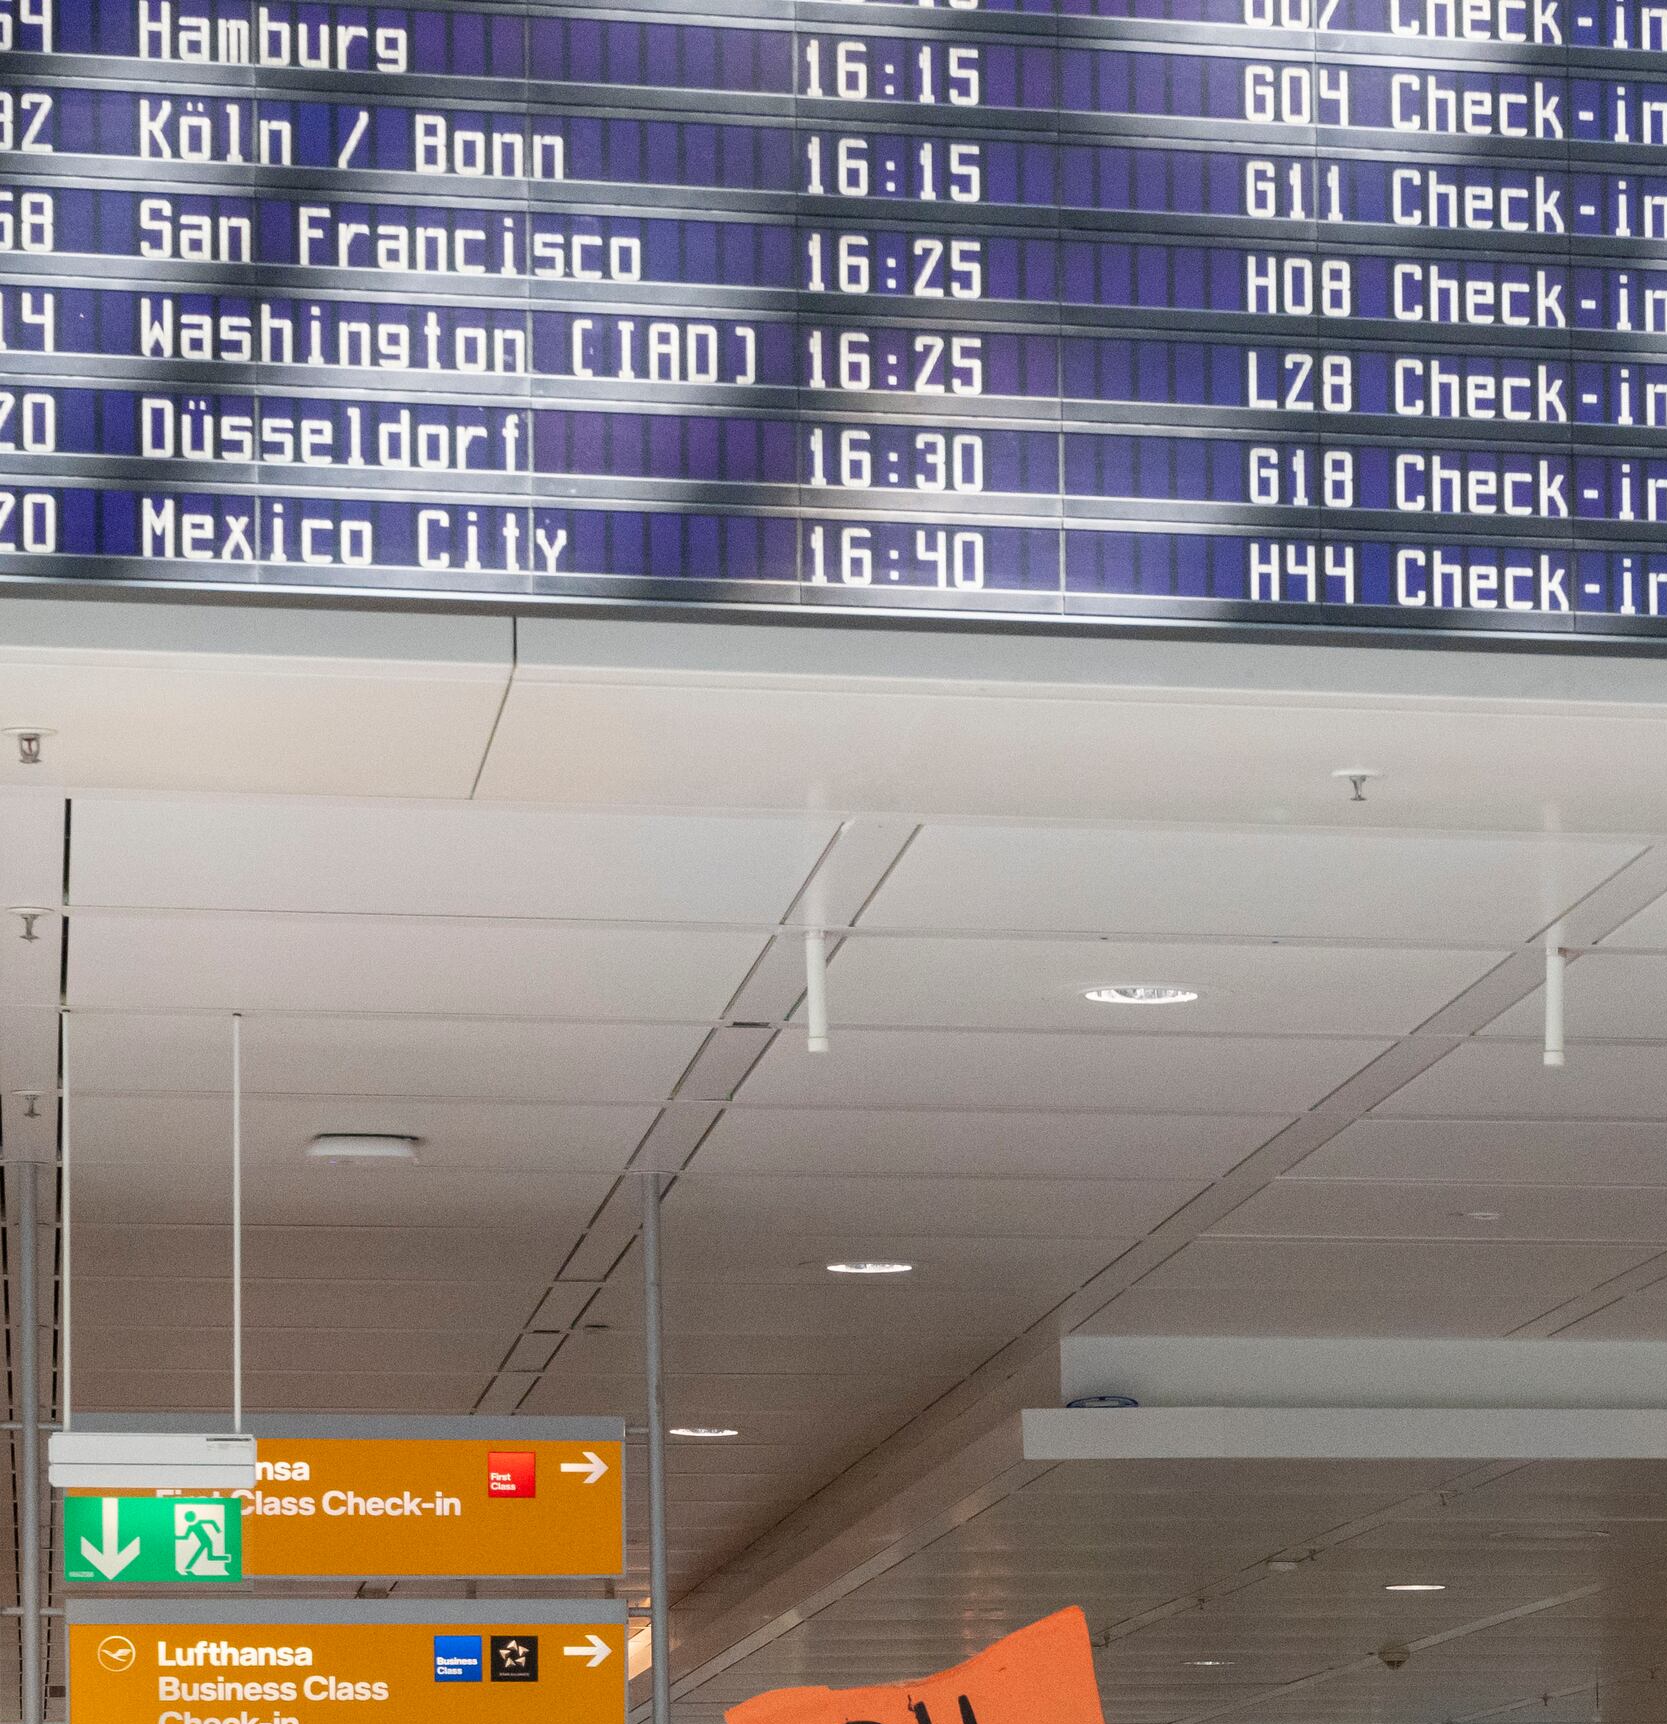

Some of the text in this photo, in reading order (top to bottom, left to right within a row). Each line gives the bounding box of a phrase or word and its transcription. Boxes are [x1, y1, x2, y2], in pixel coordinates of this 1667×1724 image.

[139, 0, 409, 75] Hamburg
[806, 39, 979, 105] 16:15
[1245, 65, 1349, 128] G04
[140, 99, 292, 165] Köln
[338, 111, 369, 169] /
[414, 114, 564, 180] Bonn
[808, 137, 981, 203] 16:15
[1246, 160, 1344, 224] G11
[140, 297, 526, 375] Washington
[810, 330, 983, 396] 16:25
[1248, 353, 1352, 414] L28
[142, 498, 373, 567] Mexico
[417, 511, 567, 575] City
[812, 525, 983, 590] 16:40
[1250, 543, 1355, 604] H44
[490, 1472, 511, 1482] First
[490, 1482, 516, 1491] Class
[231, 1490, 462, 1516] Class Check-in
[157, 1641, 313, 1667] Lufthansa
[436, 1656, 478, 1666] Business
[436, 1666, 463, 1675] Class
[158, 1676, 389, 1701] Business Class
